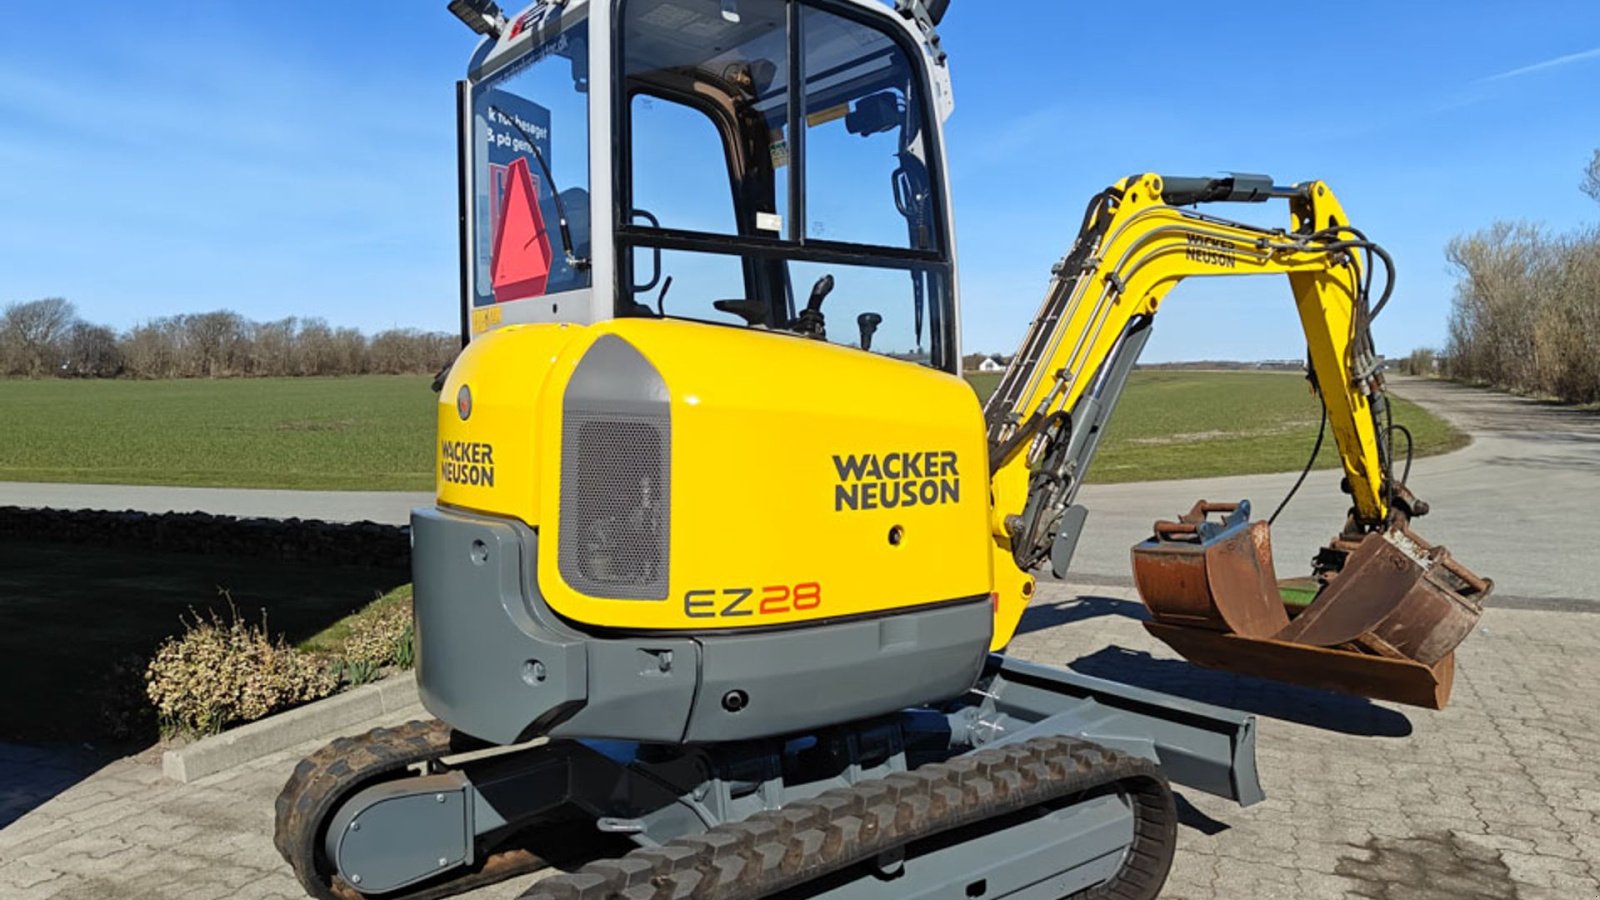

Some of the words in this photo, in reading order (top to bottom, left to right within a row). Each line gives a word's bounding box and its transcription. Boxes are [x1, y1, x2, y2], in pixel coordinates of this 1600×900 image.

[497, 132, 511, 147] på
[1185, 247, 1236, 268] NEUSON
[441, 440, 494, 465] WACKER
[441, 460, 494, 487] NEUSON
[832, 451, 959, 482] WACKER
[835, 478, 960, 512] NEUSON
[684, 582, 821, 618] EZ28
